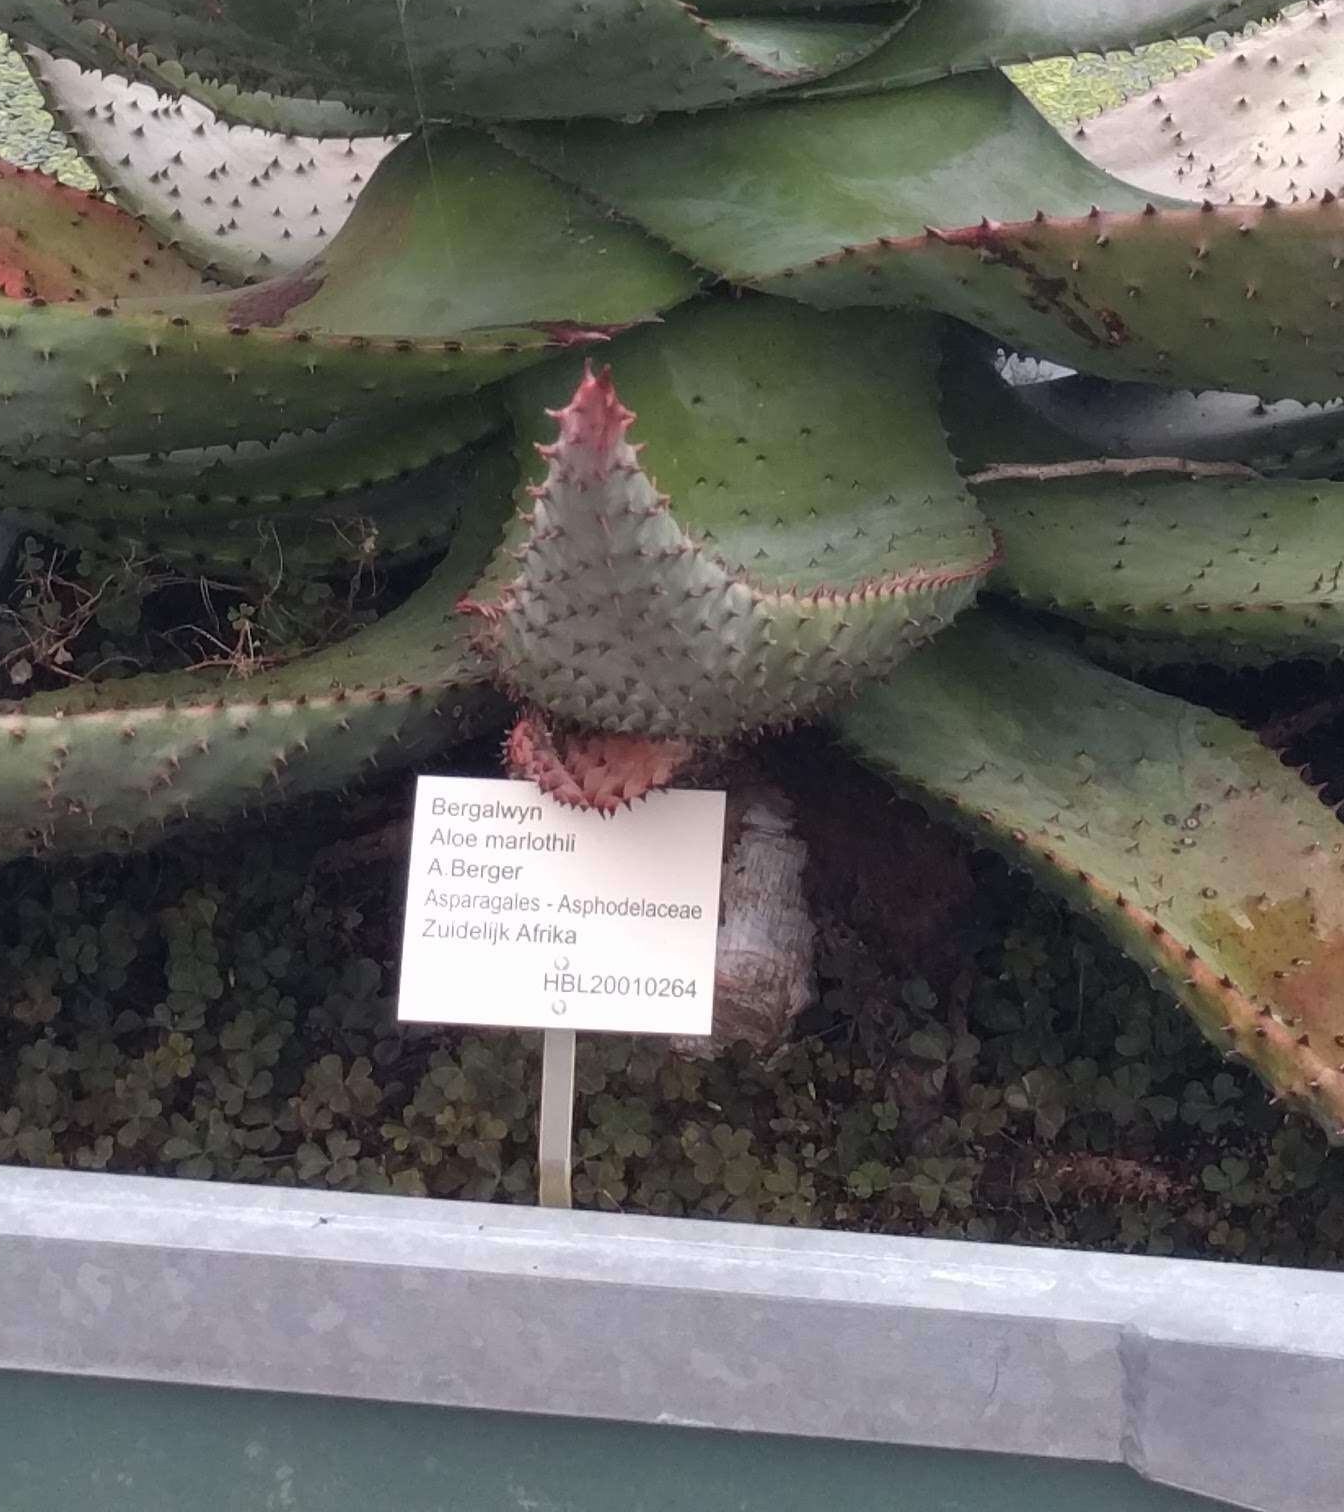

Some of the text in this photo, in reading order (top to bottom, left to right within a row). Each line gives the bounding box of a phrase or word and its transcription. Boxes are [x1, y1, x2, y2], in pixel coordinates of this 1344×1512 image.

[432, 797, 542, 824] Bergalwyn
[430, 828, 477, 847] Aloe
[427, 858, 523, 883] A.Berger
[424, 889, 540, 914] Asparagales
[557, 895, 702, 920] Asphodelaceae
[422, 919, 577, 945] Zuidelijk Afrika
[543, 974, 697, 998] HBL20010264
